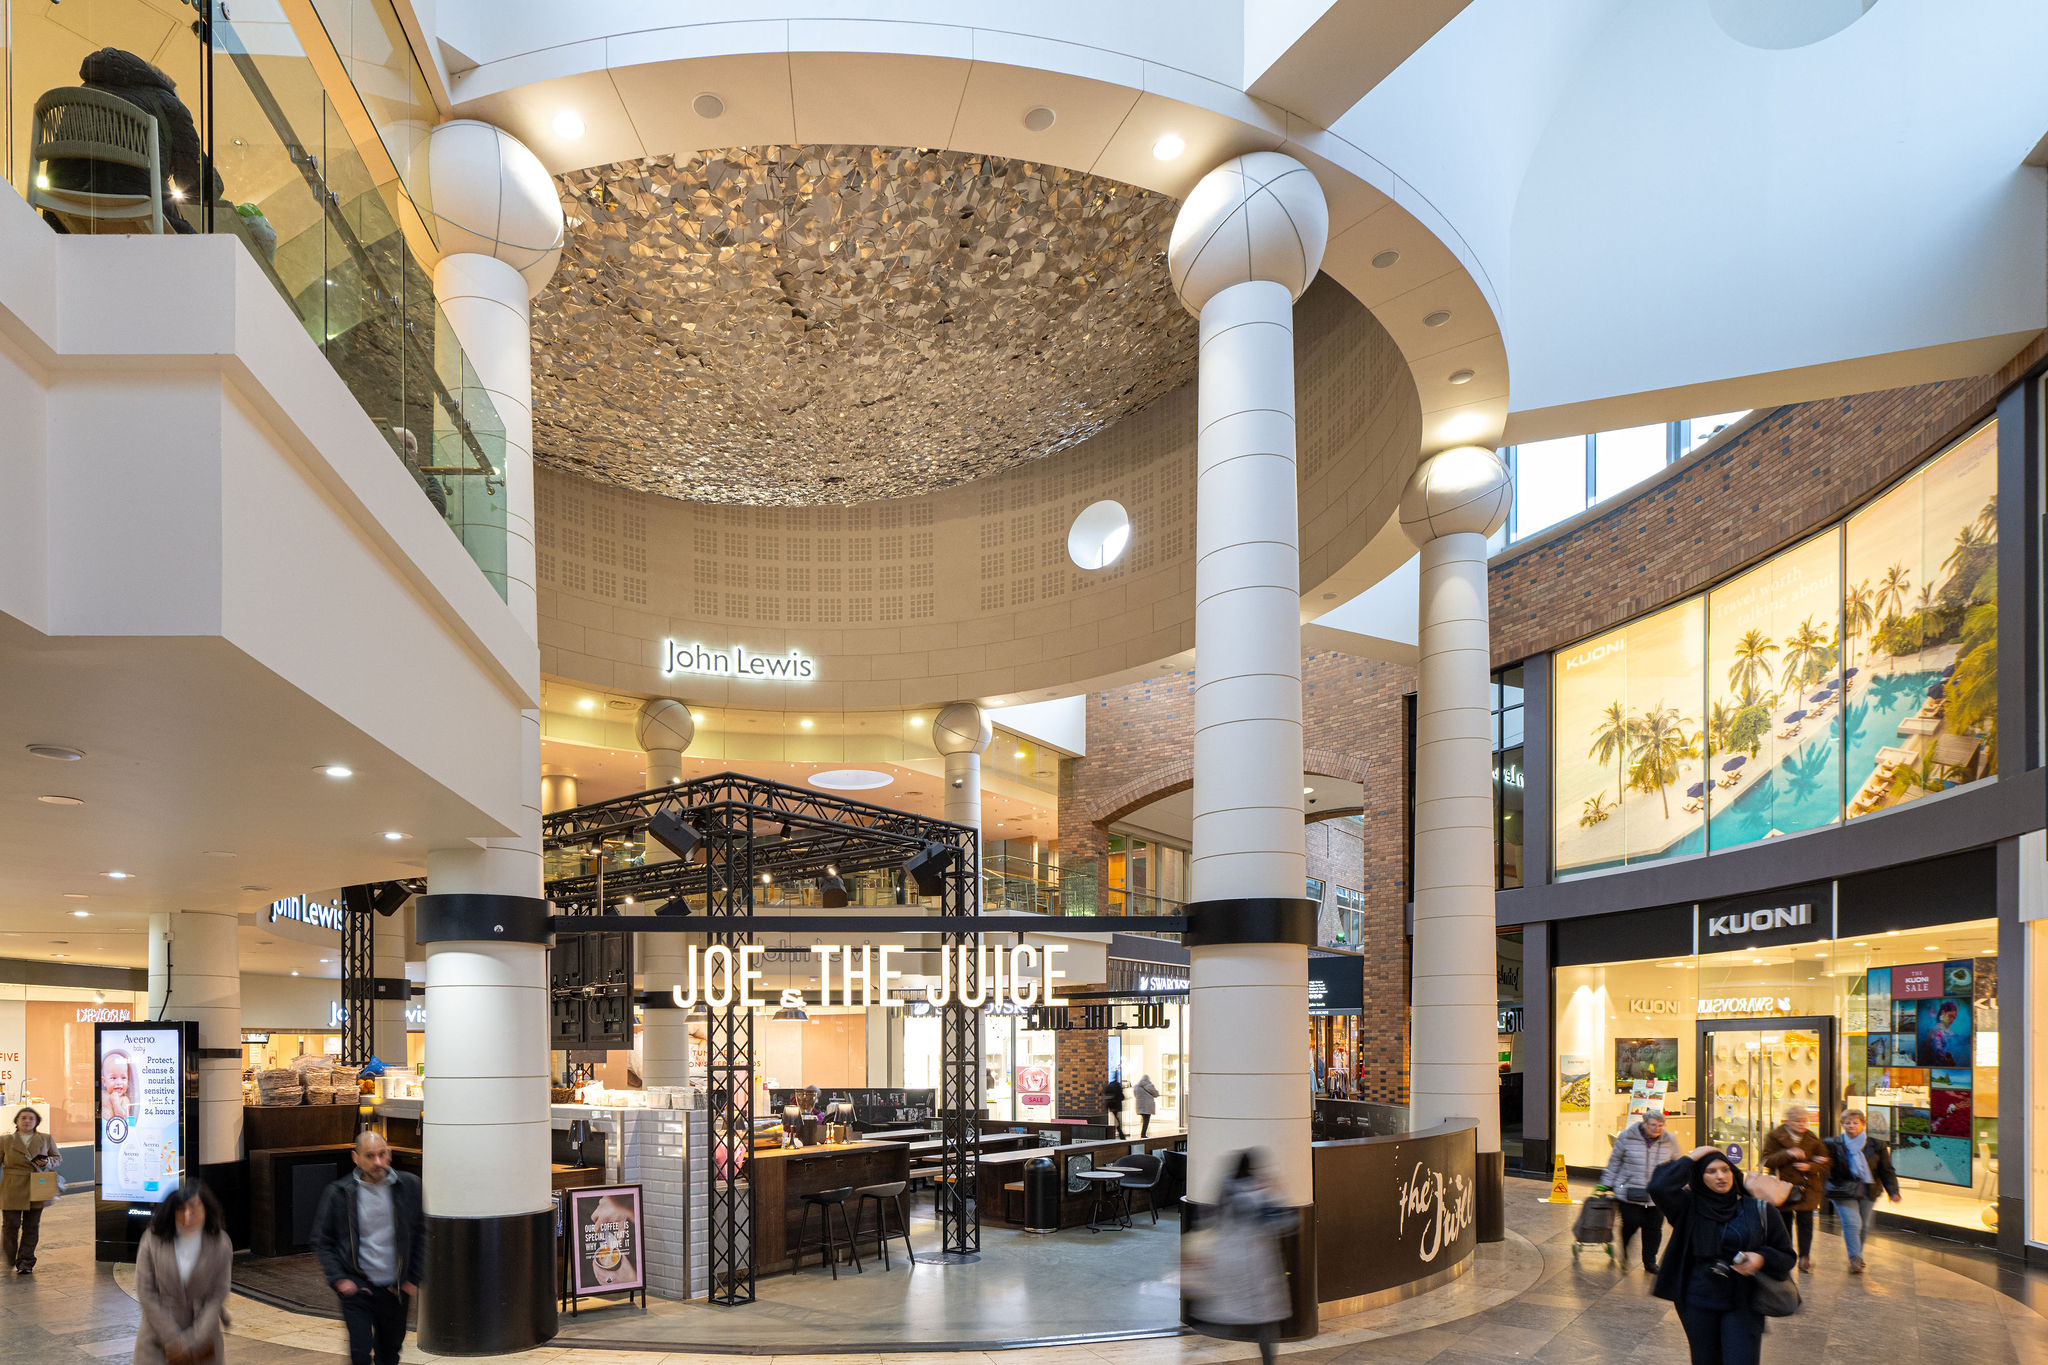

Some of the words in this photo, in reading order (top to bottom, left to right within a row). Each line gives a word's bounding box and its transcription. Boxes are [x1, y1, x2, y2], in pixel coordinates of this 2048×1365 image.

[1716, 586, 1756, 618] Travel
[1760, 565, 1801, 597] worth
[1738, 596, 1788, 629] talking
[1791, 571, 1835, 602] about
[665, 639, 729, 674] John
[737, 647, 812, 677] Lewis
[1566, 638, 1625, 671] KUONI
[1708, 903, 1812, 937] KUONI
[672, 944, 766, 1009] JOE
[779, 988, 807, 1008] &
[810, 944, 905, 1007] THE
[926, 944, 1069, 1008] JUICE
[1905, 984, 1929, 992] SALE
[1630, 999, 1681, 1014] KUONI
[124, 1035, 156, 1044] Aveeno
[147, 1056, 175, 1065] Protect,
[142, 1066, 168, 1074] cleanse
[168, 1066, 175, 1074] &
[148, 1076, 175, 1084] nourish
[144, 1086, 175, 1095] sensitive
[155, 1107, 175, 1115] hours
[585, 1225, 595, 1233] OUR
[601, 1222, 618, 1231] COFFEE
[624, 1221, 629, 1229] IS
[585, 1233, 605, 1242] SPECIAL
[586, 1242, 596, 1251] WHY
